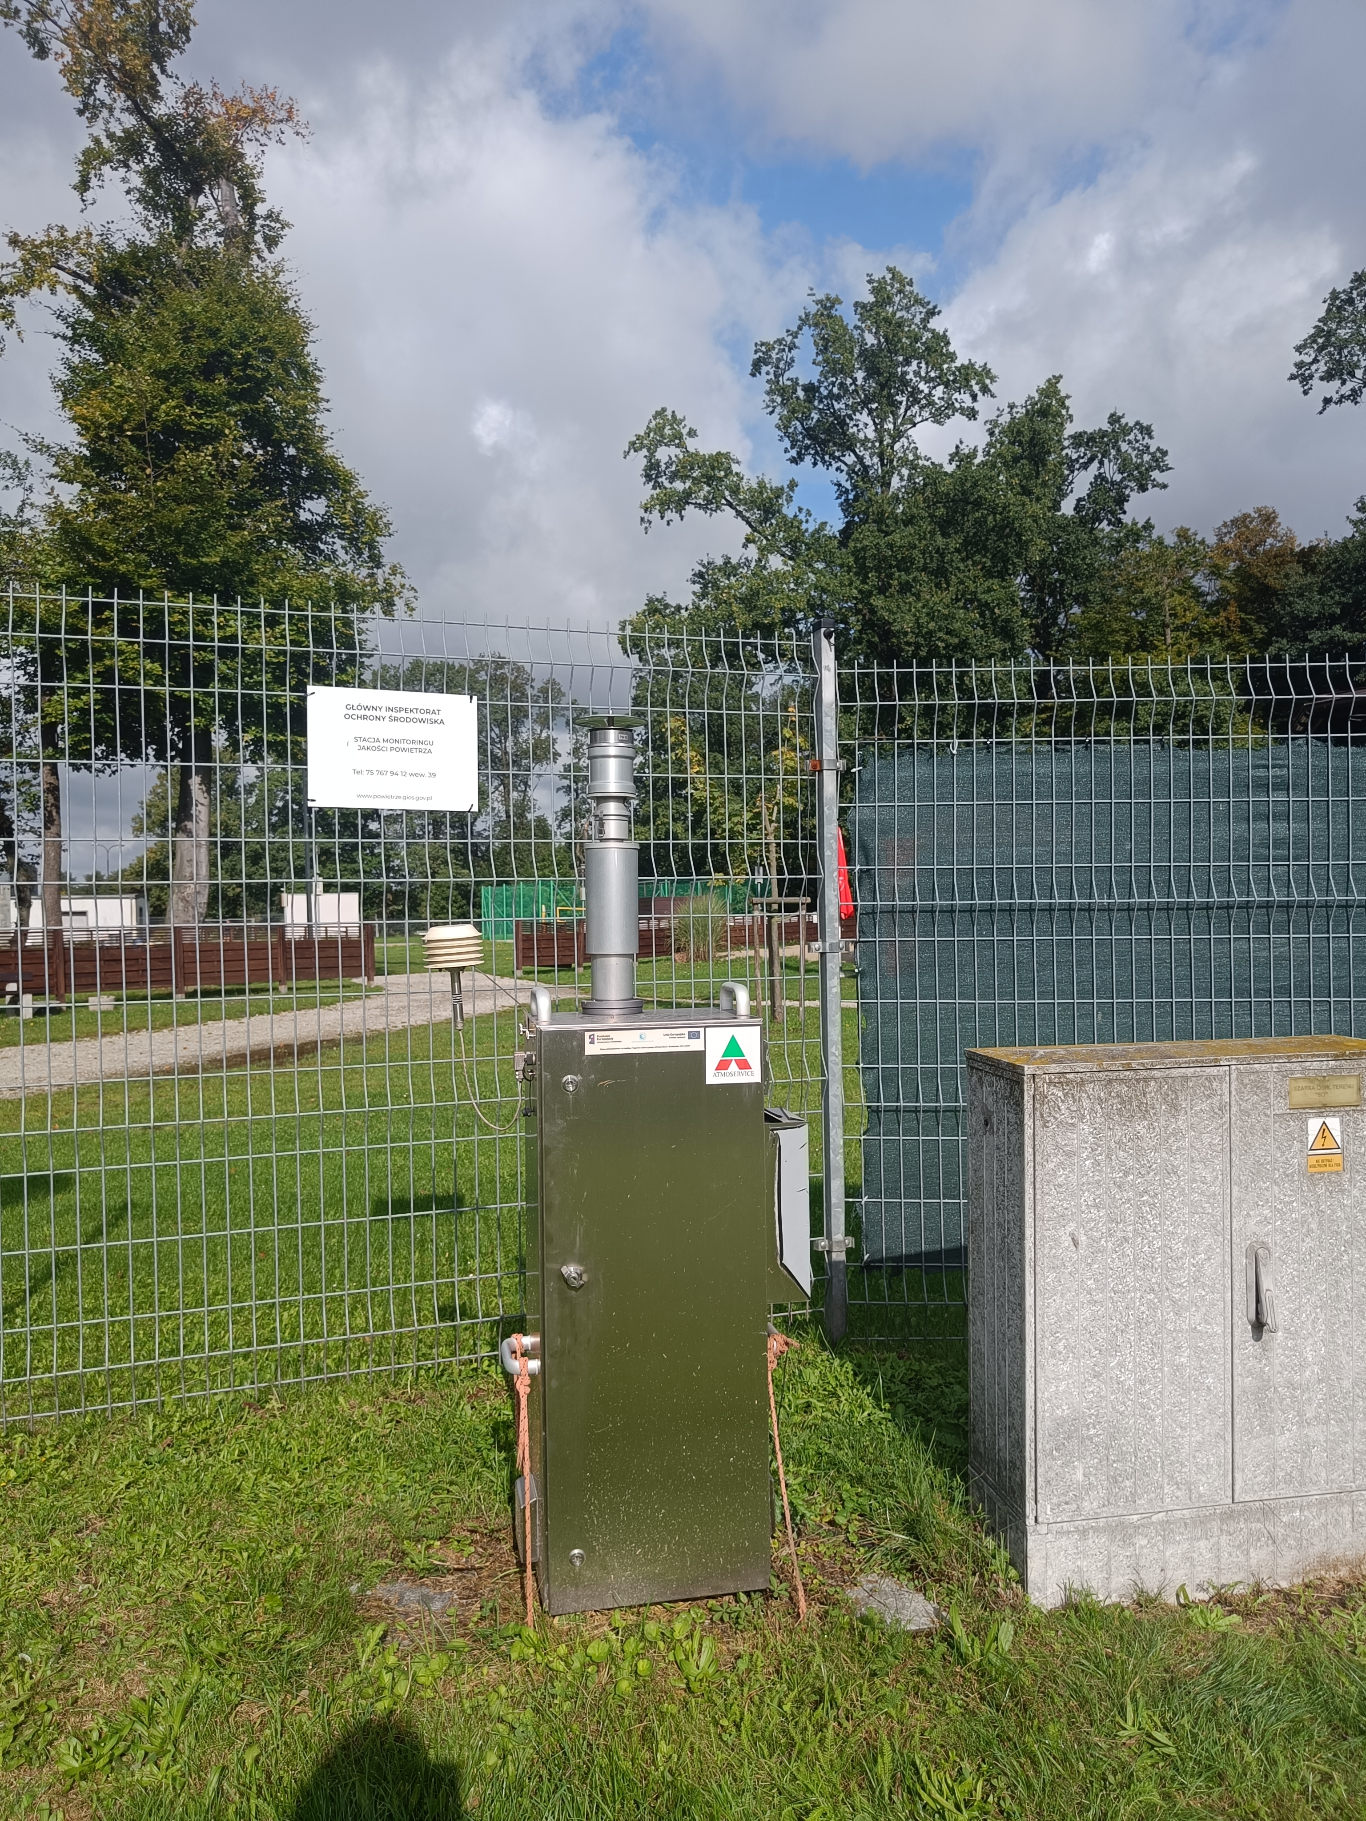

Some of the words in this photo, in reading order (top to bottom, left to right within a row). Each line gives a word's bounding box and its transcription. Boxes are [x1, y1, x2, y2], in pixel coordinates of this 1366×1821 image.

[345, 703, 383, 712] GŁÓWNY
[385, 706, 442, 715] INSPEKTORAT
[344, 713, 386, 722] OCHRONY
[388, 714, 445, 725] ŚRODOWISKA
[354, 736, 381, 744] STACJA
[382, 738, 434, 746] MONITORINGU
[389, 746, 433, 754] POWIETRZA
